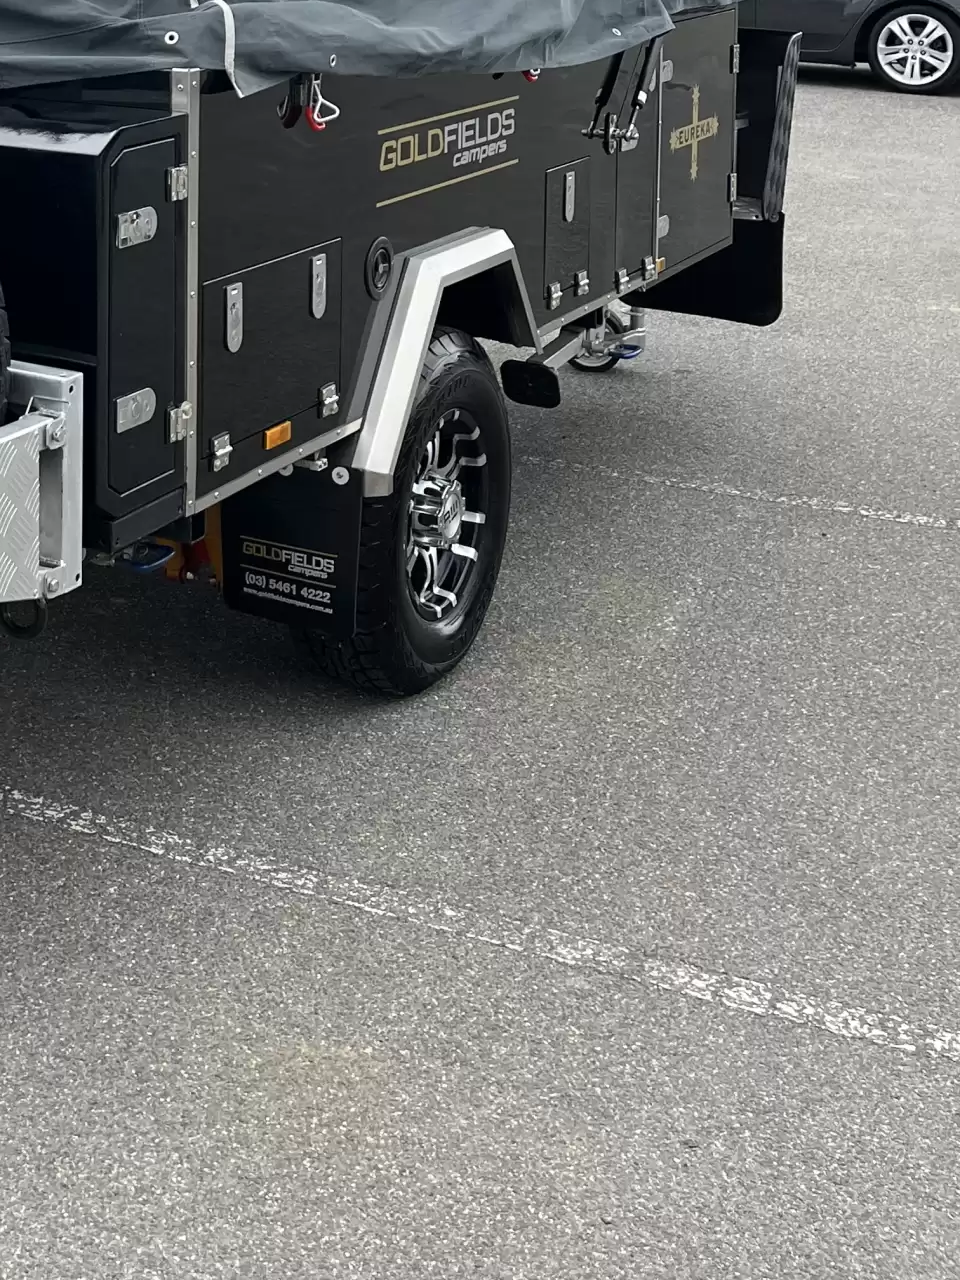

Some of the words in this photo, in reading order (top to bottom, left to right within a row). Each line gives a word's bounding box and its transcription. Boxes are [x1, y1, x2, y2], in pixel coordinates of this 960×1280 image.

[380, 108, 515, 171] GOLDFIELDS
[679, 121, 711, 145] EUREKA
[453, 139, 507, 167] campers
[243, 541, 335, 573] GOLDFIELDS
[287, 564, 328, 579] campers
[245, 572, 266, 588] (03)
[269, 578, 297, 595] 5461
[300, 586, 331, 603] 4222
